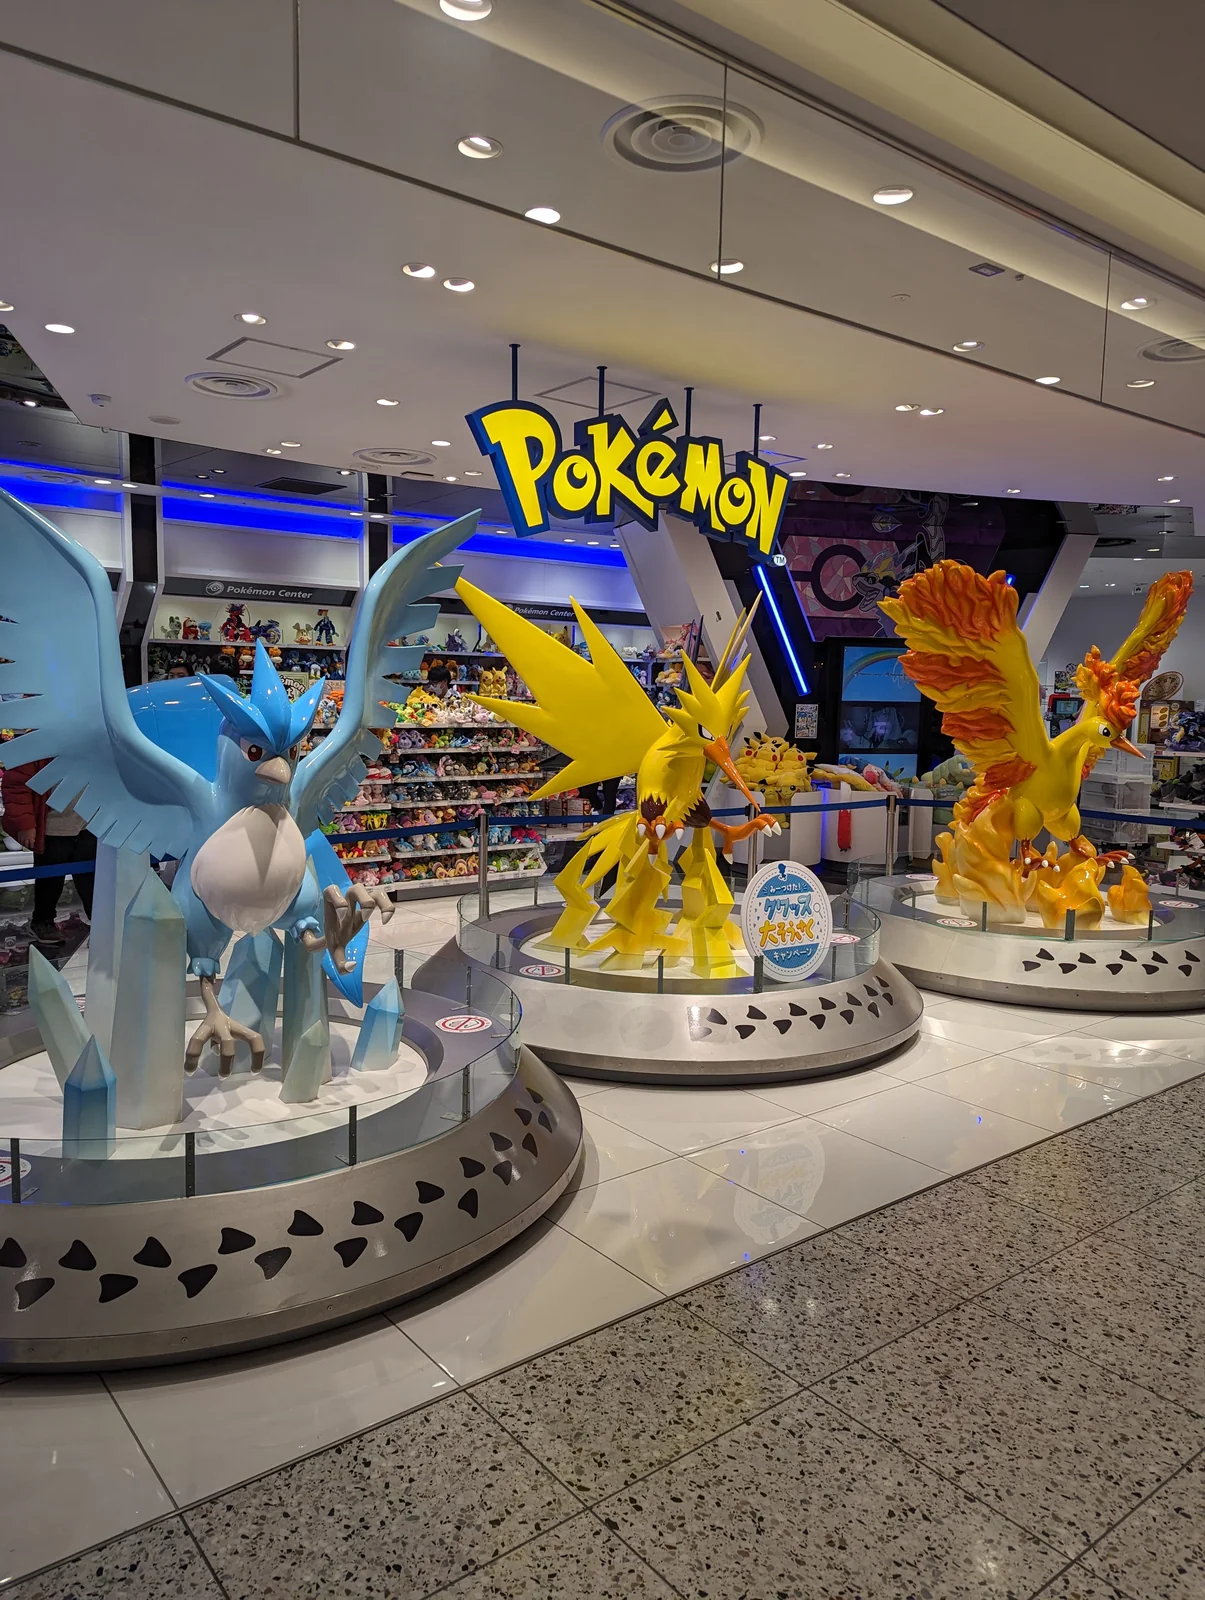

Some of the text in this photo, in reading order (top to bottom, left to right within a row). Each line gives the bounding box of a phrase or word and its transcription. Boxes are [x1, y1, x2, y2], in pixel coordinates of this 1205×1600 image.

[226, 585, 313, 599] Pokémon Center
[514, 606, 575, 618] Pokémon Center
[773, 948, 812, 961] キャンペーン
